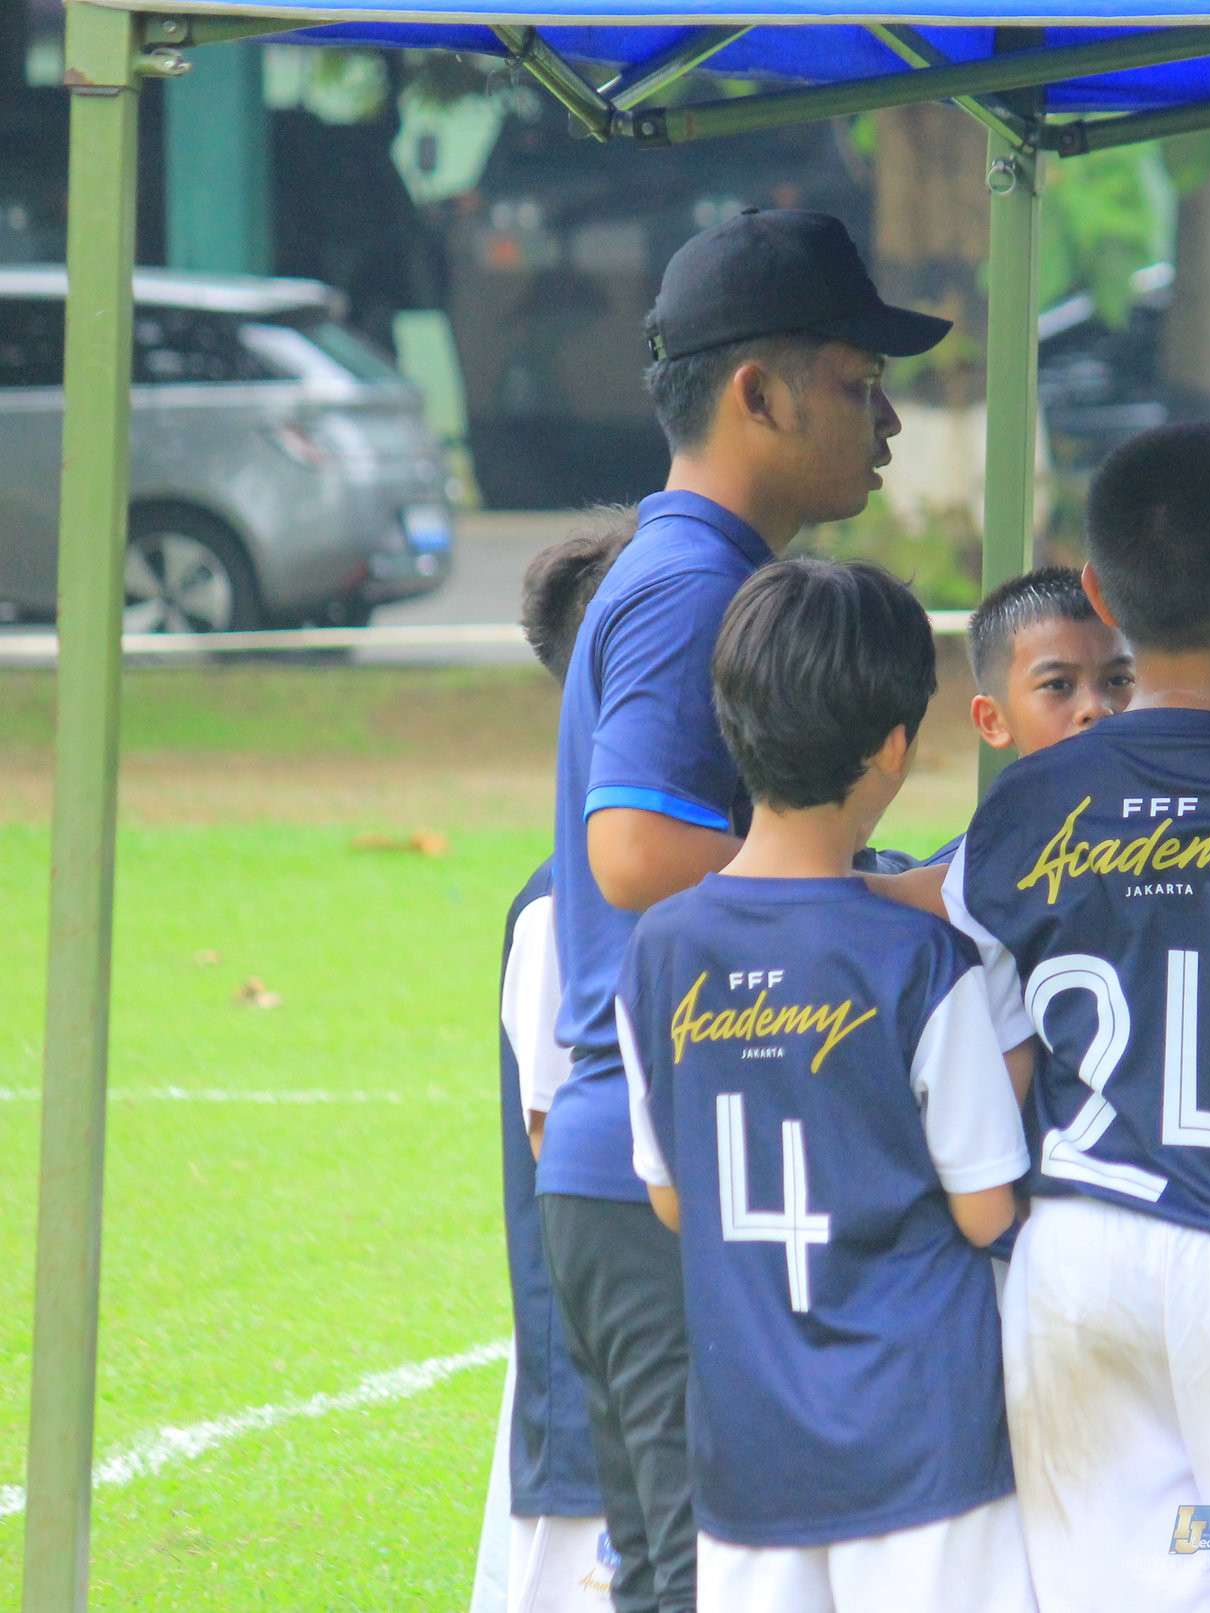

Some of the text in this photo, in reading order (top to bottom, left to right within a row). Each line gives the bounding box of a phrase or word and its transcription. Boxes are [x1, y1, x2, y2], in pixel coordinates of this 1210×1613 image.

[1123, 797, 1198, 818] FFF
[1125, 884, 1194, 898] JAKARTA
[729, 970, 785, 991] FFF
[671, 972, 877, 1074] Academy
[741, 1047, 784, 1060] JAKARTA
[716, 1093, 830, 1312] 4
